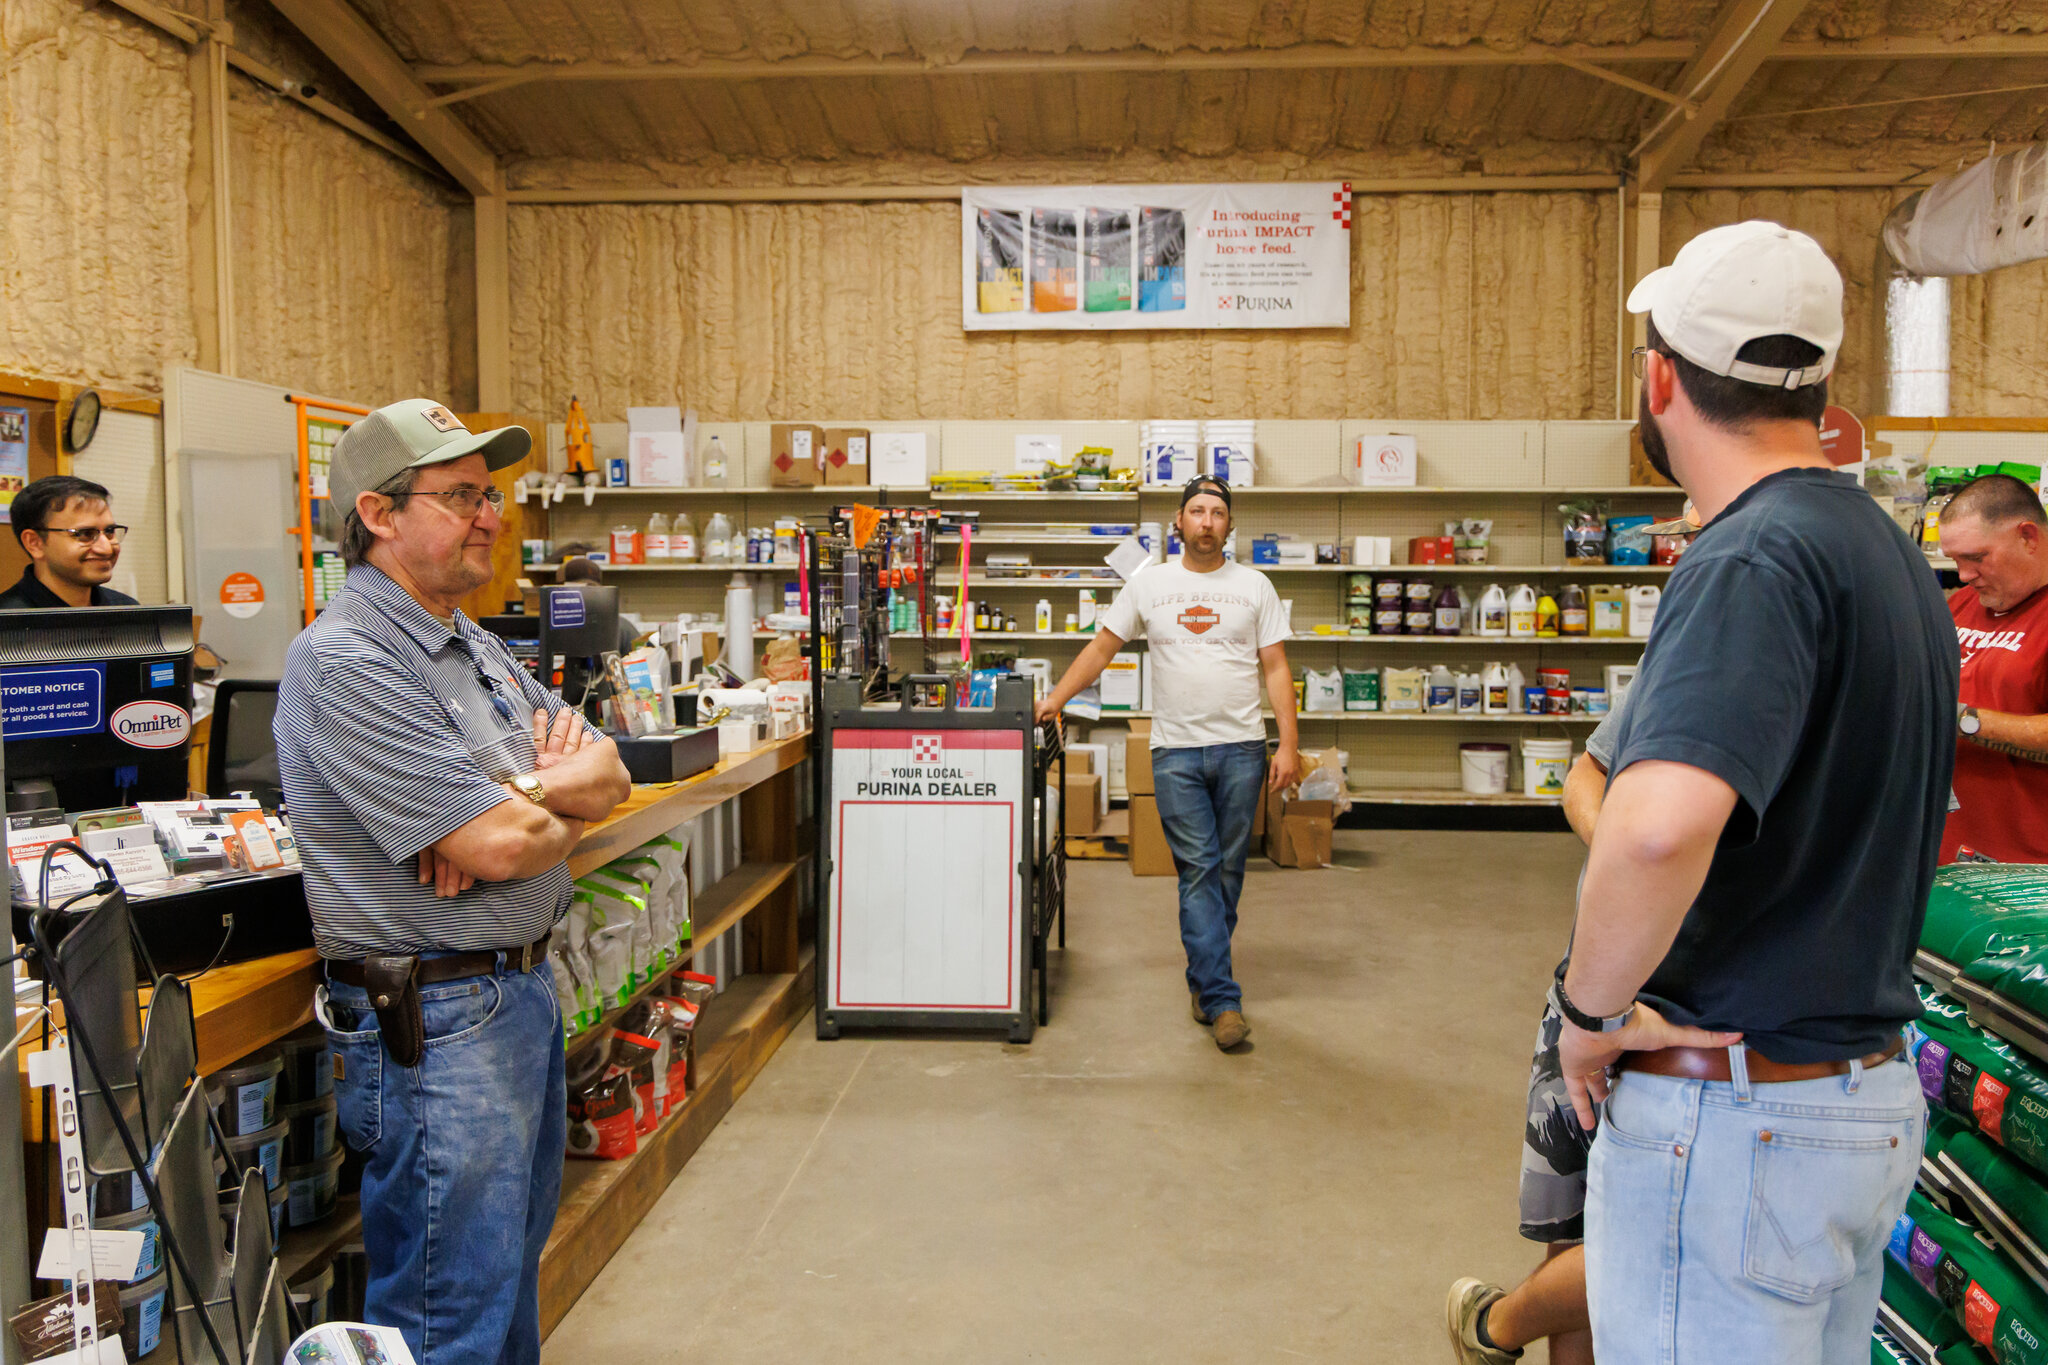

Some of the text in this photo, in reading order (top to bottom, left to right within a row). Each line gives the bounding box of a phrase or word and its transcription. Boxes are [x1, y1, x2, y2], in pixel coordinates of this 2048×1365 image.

[1255, 225, 1315, 238] IMPACT
[1262, 242, 1297, 254] feed.
[1144, 266, 1185, 282] IMPACT
[1236, 295, 1293, 312] PURINA
[1152, 591, 1250, 608] LIFE BEGINS
[44, 682, 85, 694] NOTICE
[9, 705, 29, 714] both
[37, 703, 54, 711] card
[72, 701, 90, 709] cash
[11, 714, 21, 722] all
[22, 712, 47, 722] goods
[49, 711, 55, 719] &
[56, 709, 89, 718] services.
[119, 714, 182, 735] OmniPet
[891, 767, 964, 779] YOUR LOCAL
[857, 782, 997, 797] PURINA DEALER
[12, 842, 45, 855] Window
[2019, 1095, 2048, 1120] EQCEED
[2010, 1318, 2039, 1350] EQCEED
